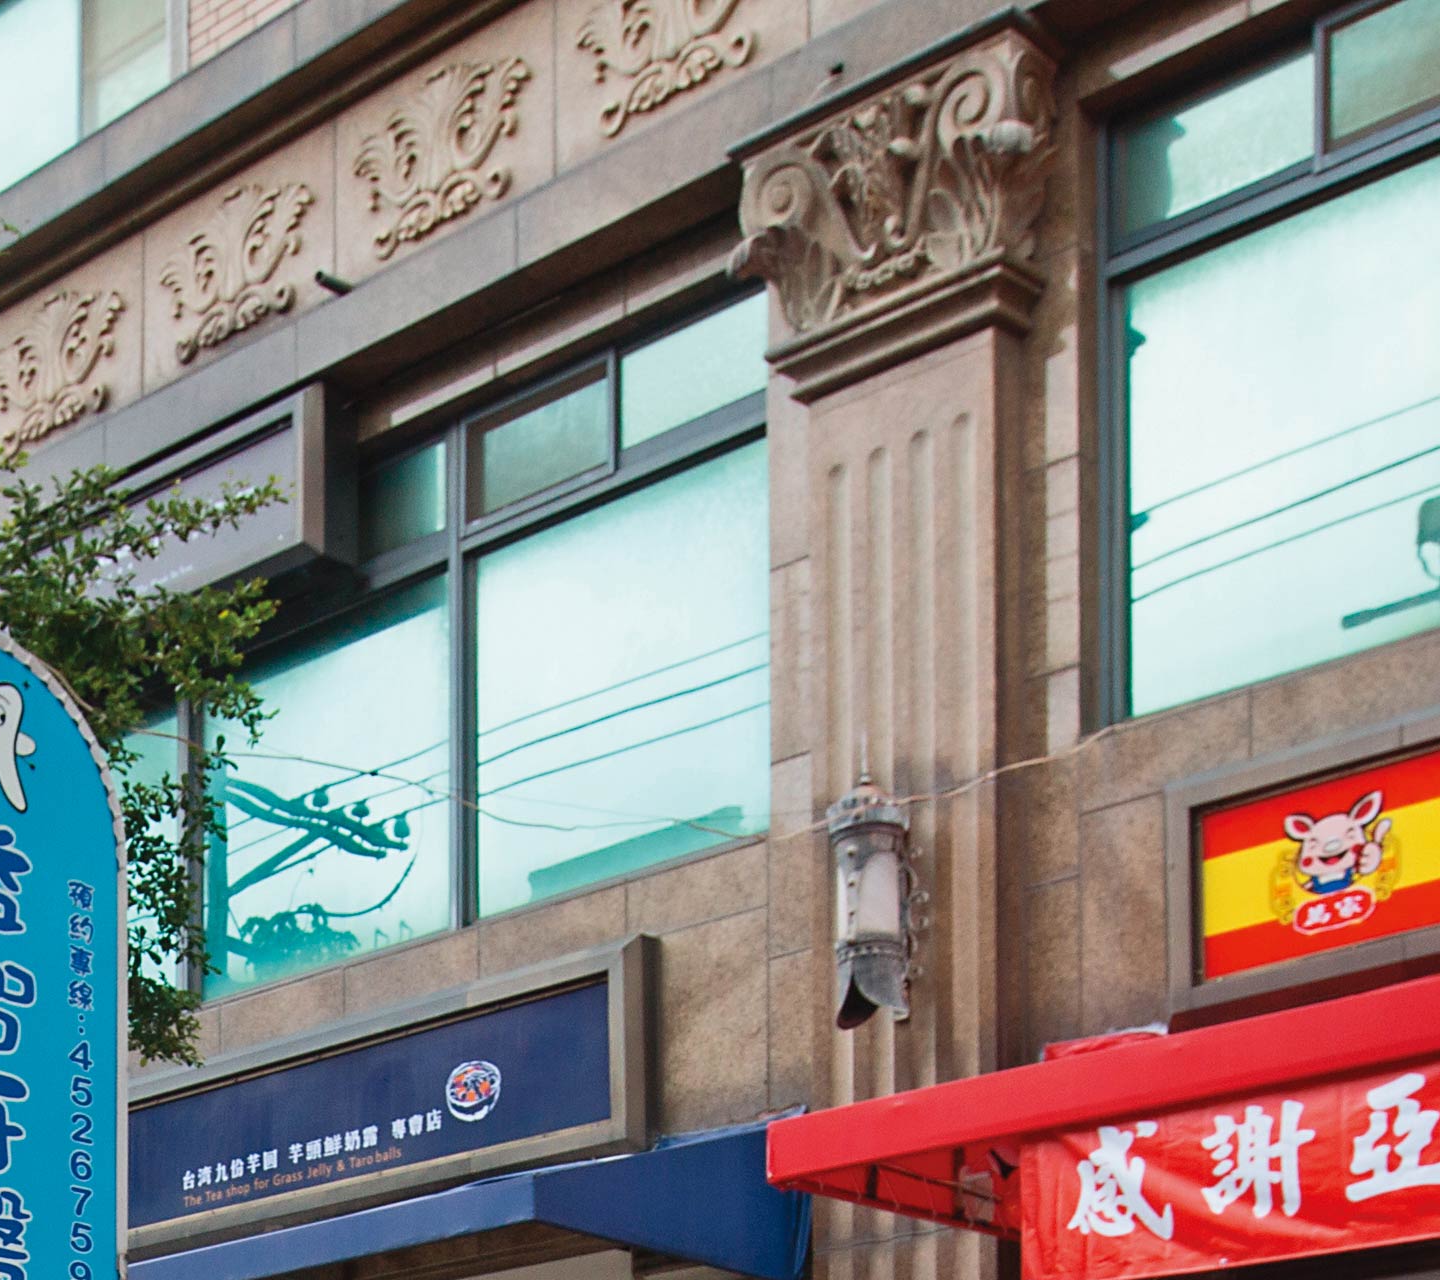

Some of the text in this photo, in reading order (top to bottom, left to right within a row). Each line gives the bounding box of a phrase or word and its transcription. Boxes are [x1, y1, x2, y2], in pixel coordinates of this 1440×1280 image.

[184, 1147, 402, 1208] The Tea shop for Grass Jelly & Taro balls
